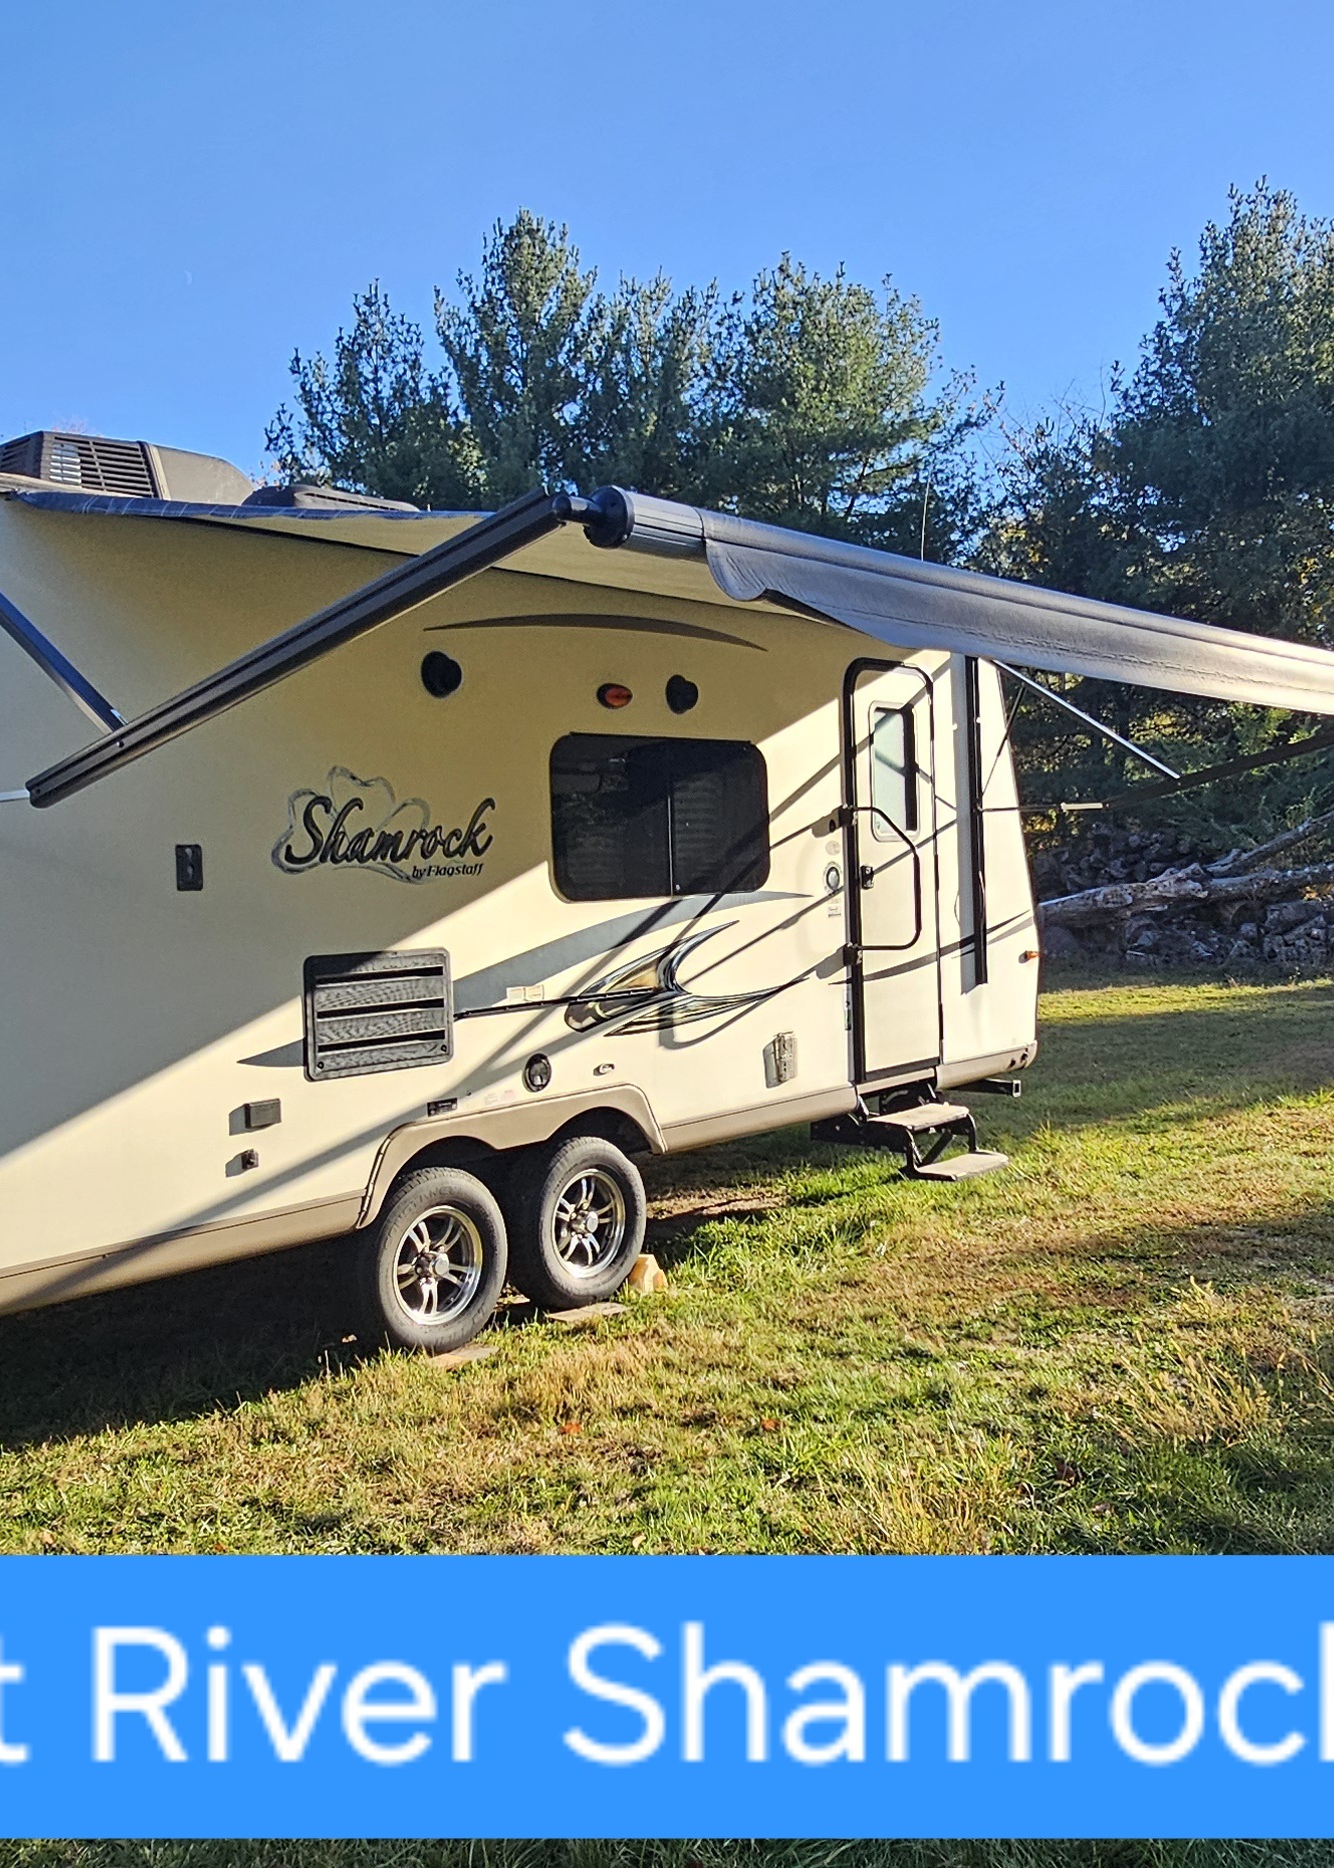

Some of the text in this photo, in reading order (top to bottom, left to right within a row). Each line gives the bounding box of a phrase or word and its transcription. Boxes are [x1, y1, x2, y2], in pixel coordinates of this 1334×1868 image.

[284, 796, 496, 865] Shamrock
[412, 863, 484, 880] by Flagstaff
